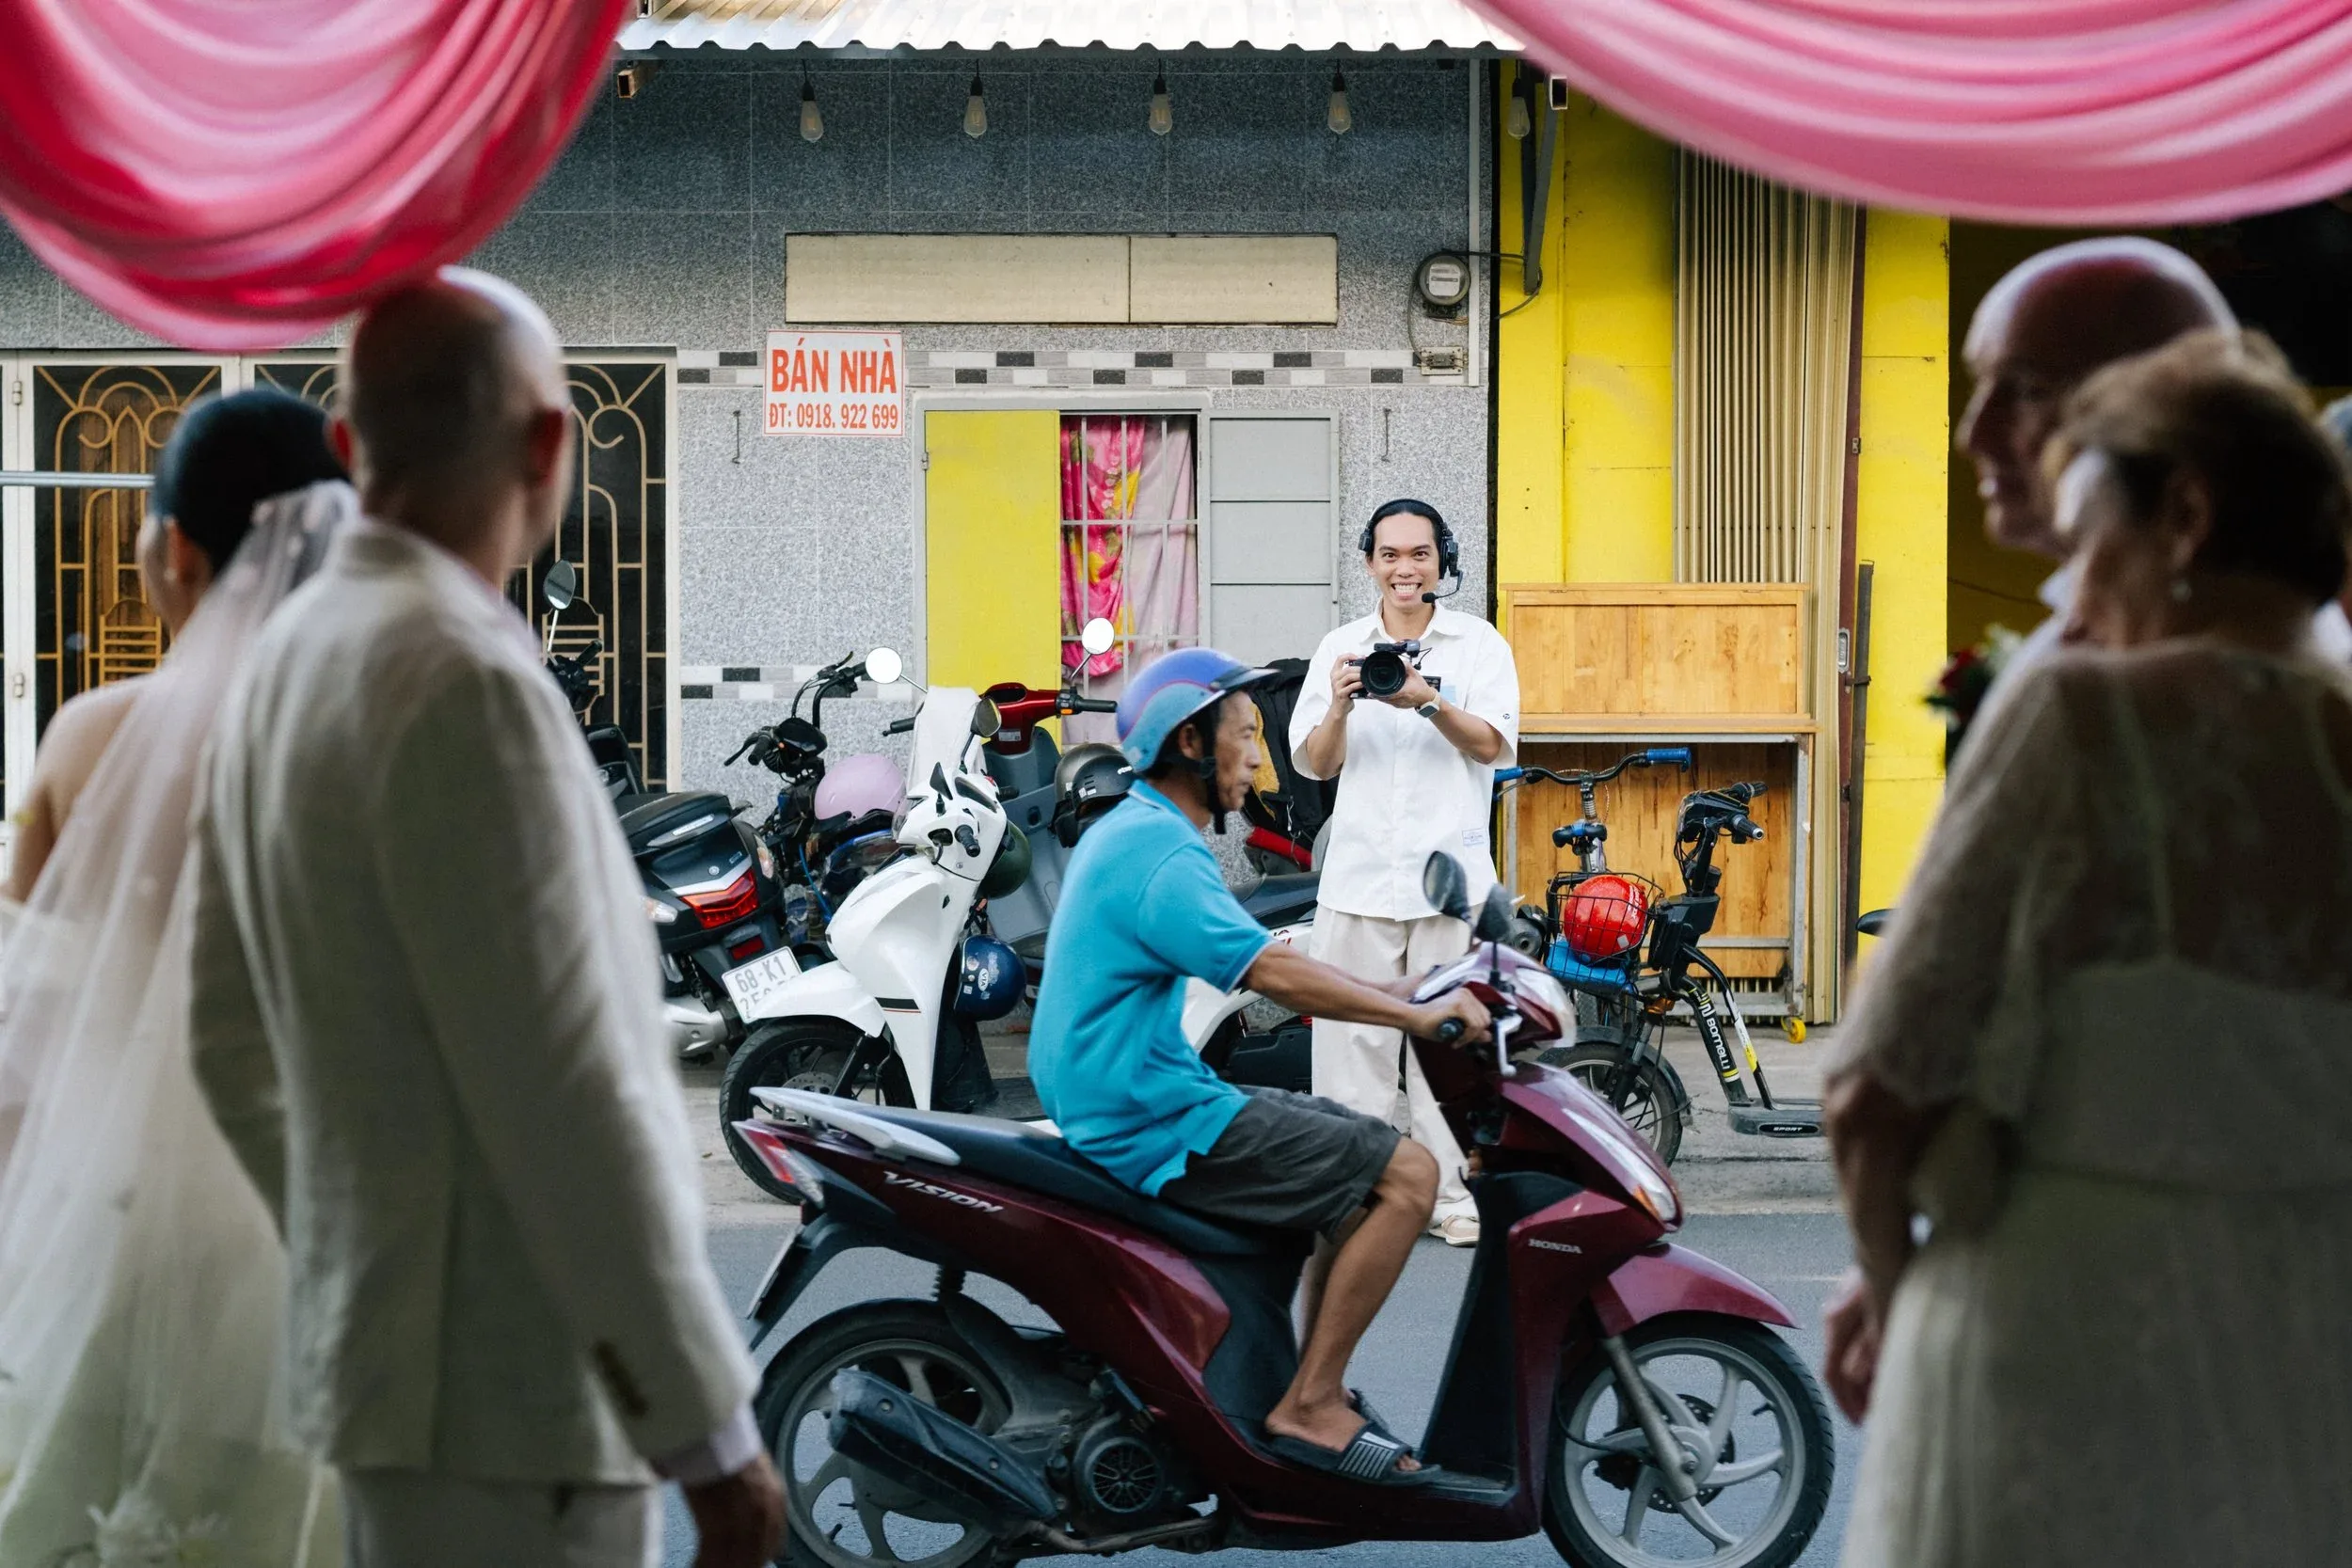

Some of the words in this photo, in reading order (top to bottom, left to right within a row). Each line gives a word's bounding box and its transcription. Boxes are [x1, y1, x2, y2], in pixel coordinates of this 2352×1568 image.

[771, 337, 829, 393] BÁN
[840, 339, 898, 394] NHÀ
[769, 403, 792, 428] ĐT:
[797, 403, 835, 429] 0918.
[841, 404, 867, 429] 922
[872, 404, 898, 430] 699
[735, 956, 787, 992] 68-K1
[882, 1170, 1005, 1213] VISION
[1528, 1238, 1583, 1254] HONDA
